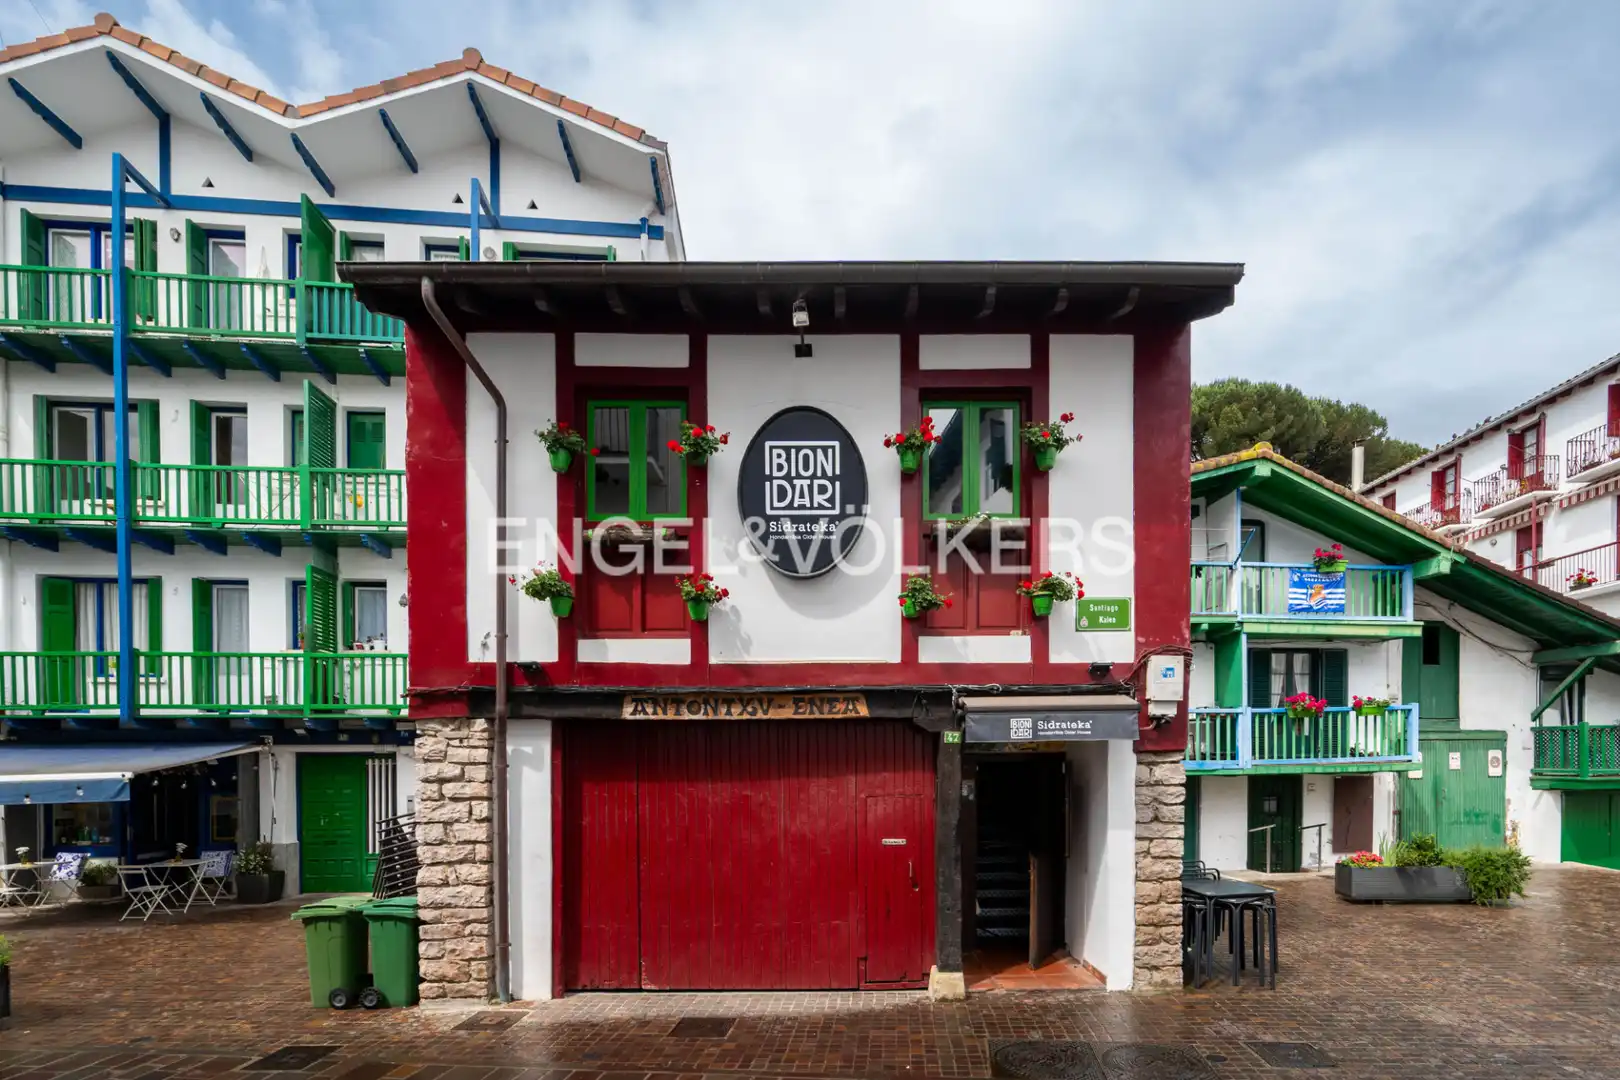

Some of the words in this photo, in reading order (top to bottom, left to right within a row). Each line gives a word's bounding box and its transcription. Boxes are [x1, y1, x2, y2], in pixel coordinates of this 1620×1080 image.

[772, 448, 833, 477] BION
[772, 479, 833, 508] DAR
[1089, 604, 1119, 613] Santiago
[792, 697, 861, 715] ENEA
[1012, 720, 1030, 729] BION
[1037, 720, 1091, 729] Sidrateka
[1012, 729, 1030, 737] DAR
